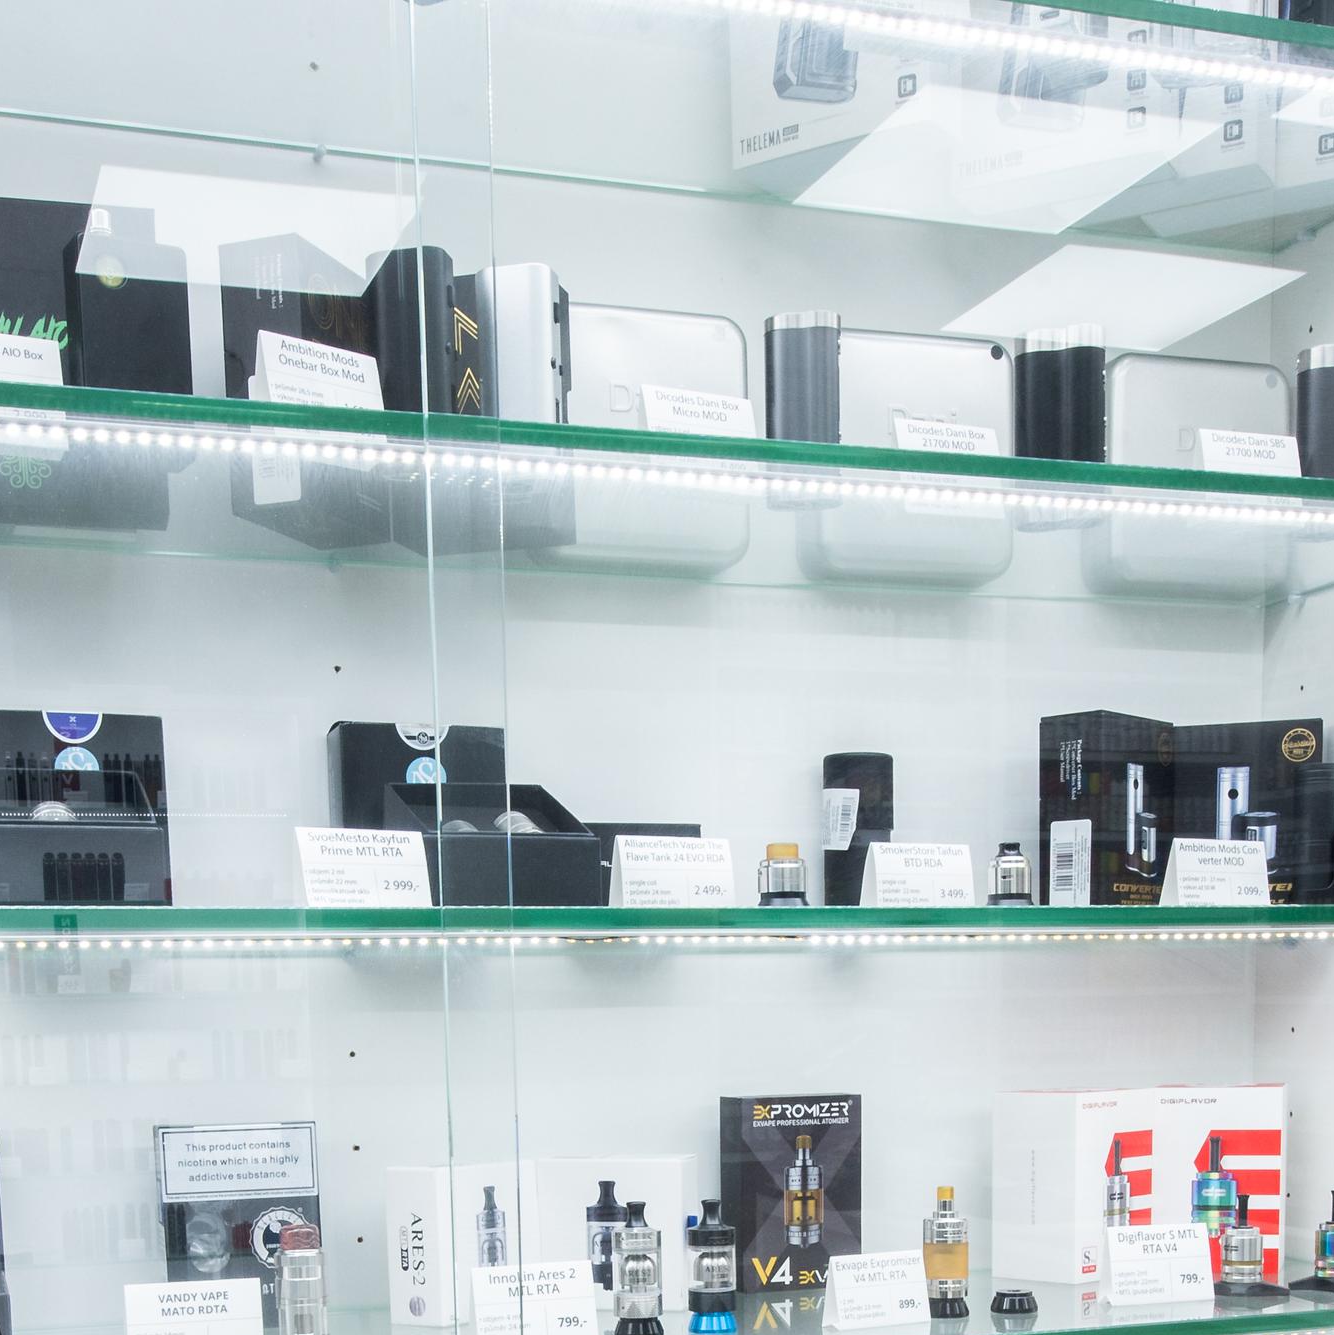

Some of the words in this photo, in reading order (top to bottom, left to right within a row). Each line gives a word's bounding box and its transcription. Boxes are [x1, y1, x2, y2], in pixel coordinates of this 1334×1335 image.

[2, 346, 21, 358] AIO
[24, 350, 43, 360] Box
[753, 1102, 849, 1120] EXPROMIZER
[185, 1143, 205, 1153] This
[209, 1141, 245, 1154] product
[249, 1139, 290, 1151] contains
[178, 1157, 217, 1168] nicotine
[220, 1155, 247, 1167] which
[251, 1155, 259, 1165] is
[271, 1154, 299, 1167] highly
[189, 1171, 233, 1183] addictive
[237, 1168, 290, 1181] substance.
[752, 1256, 793, 1286] V4
